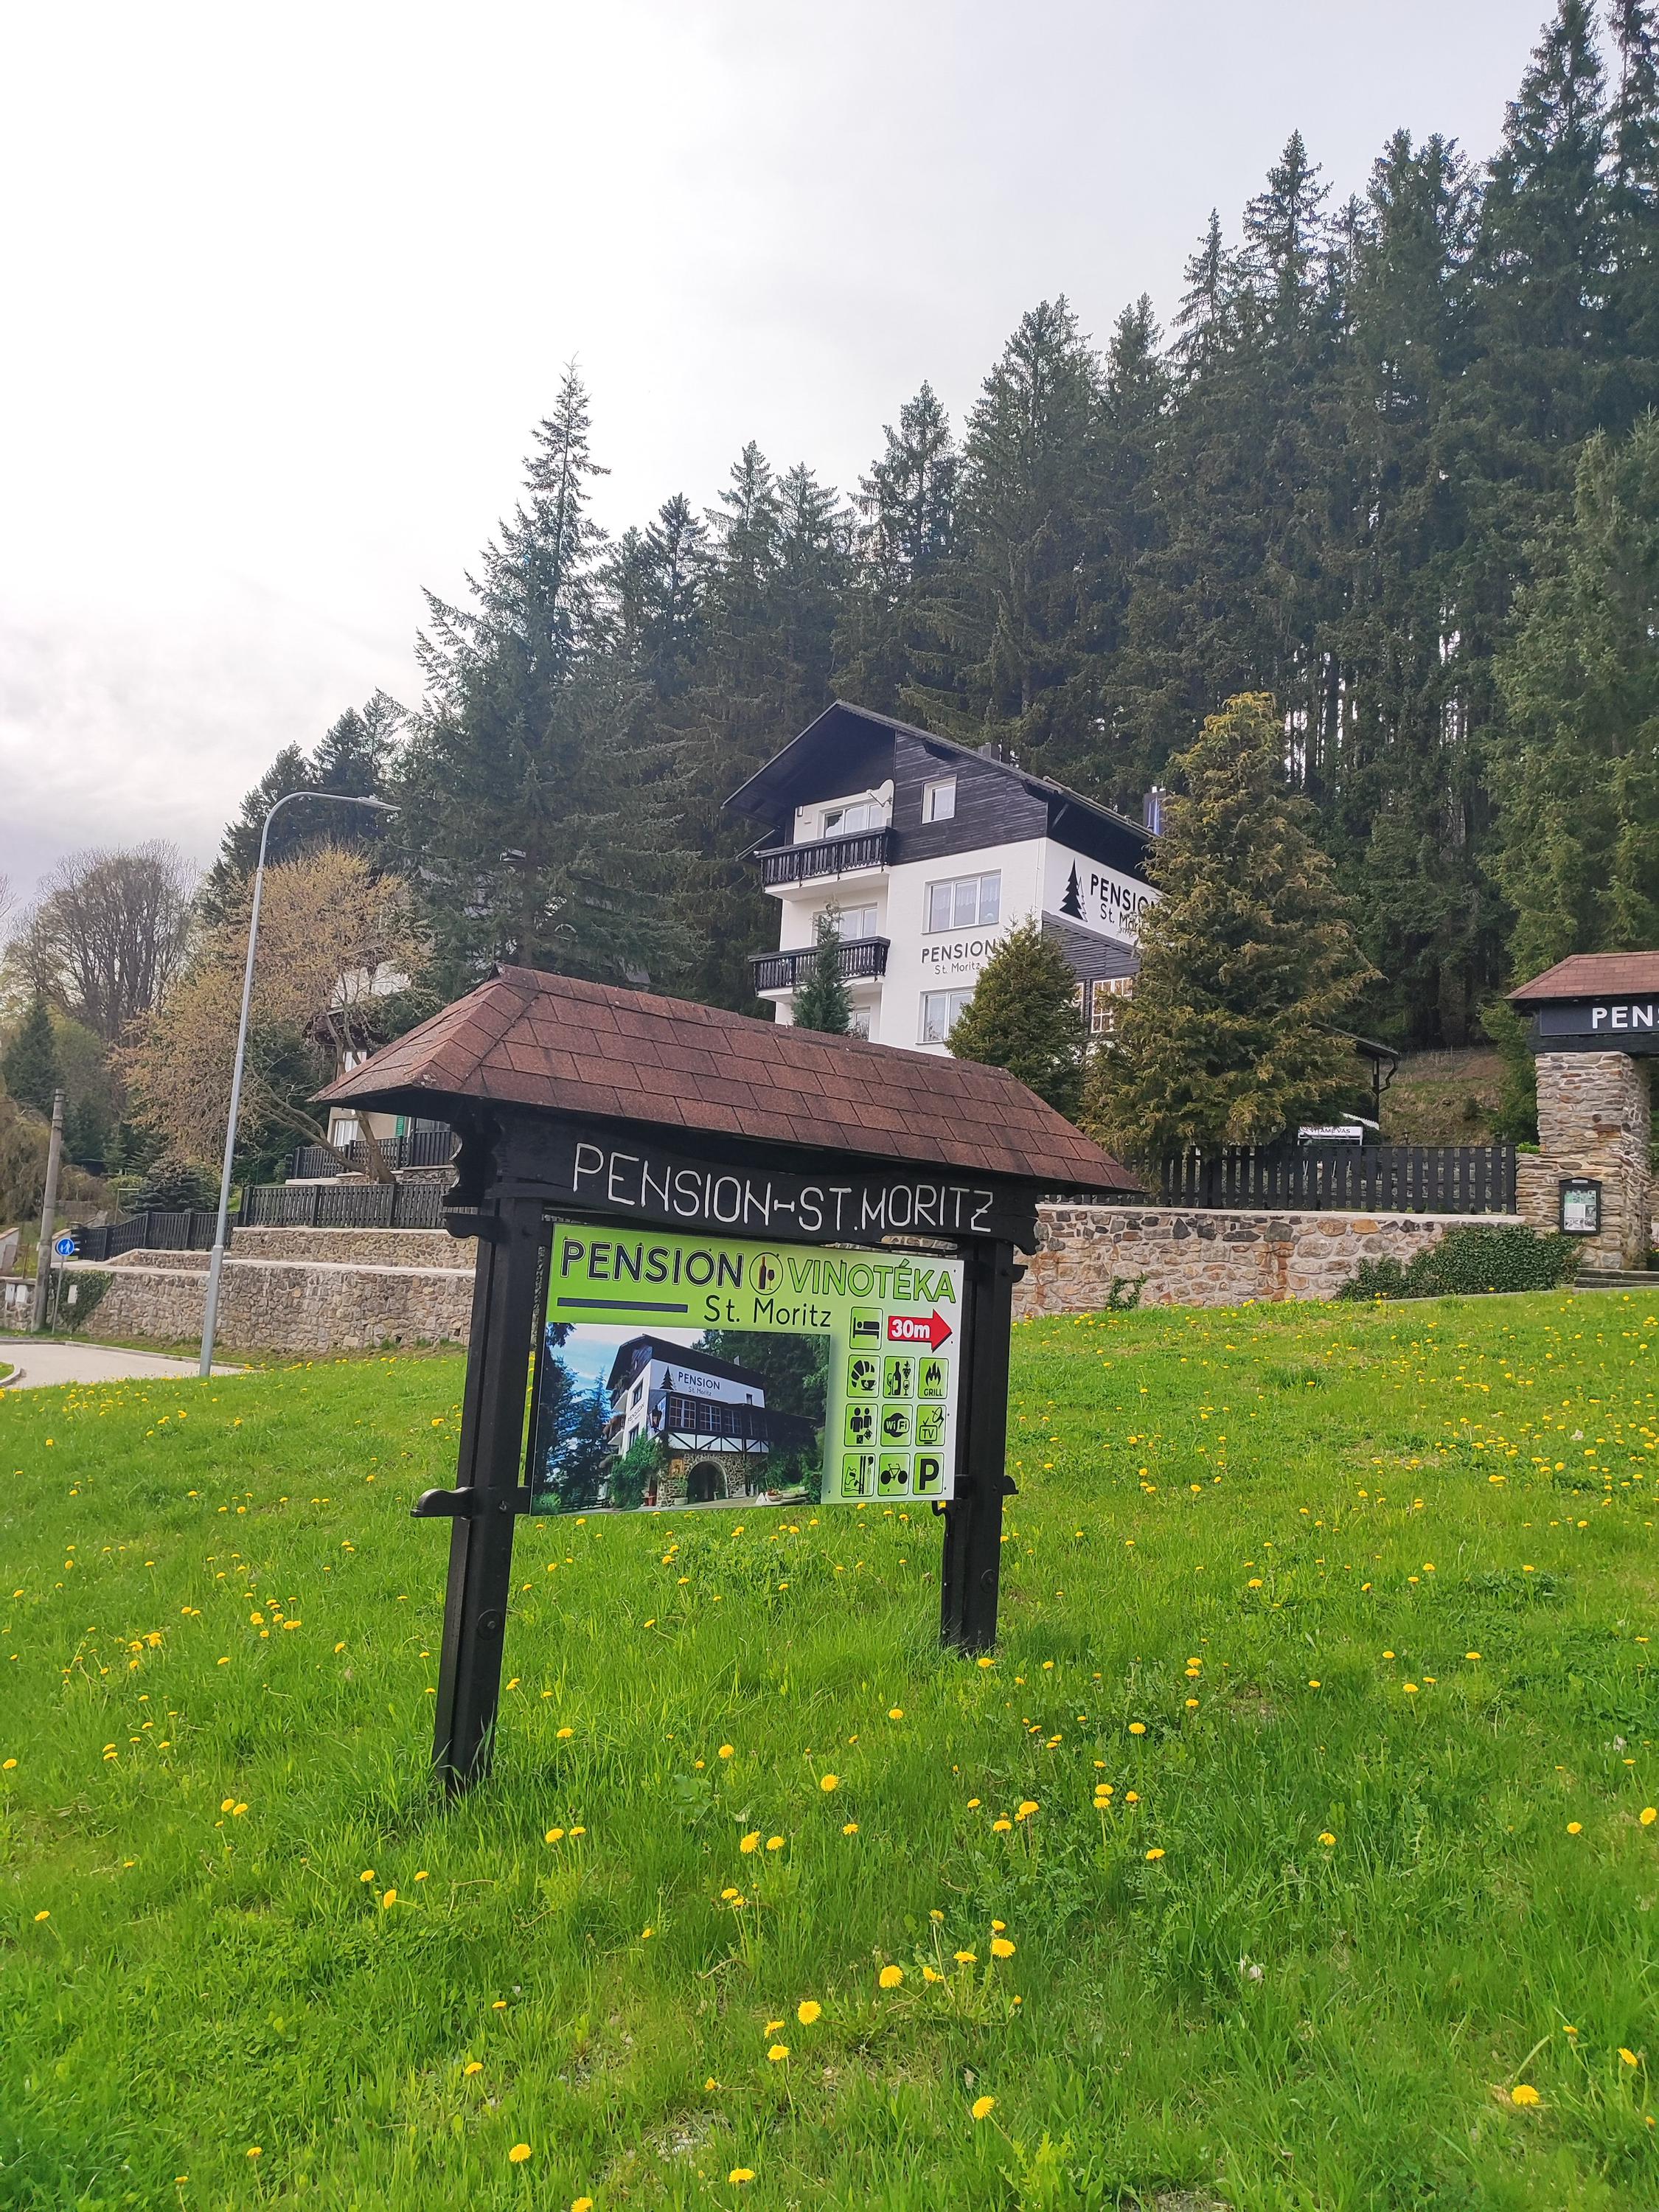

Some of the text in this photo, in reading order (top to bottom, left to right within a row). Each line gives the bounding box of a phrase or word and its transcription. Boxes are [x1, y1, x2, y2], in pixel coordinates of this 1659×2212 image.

[1100, 902, 1115, 924] St.
[922, 938, 996, 964] PENSION
[934, 961, 981, 975] St. Moritz
[1592, 1004, 1659, 1029] PEN
[560, 1238, 956, 1304] PENSION VINOTÉKA
[703, 1294, 832, 1327] St. Moritz
[891, 1318, 931, 1339] 30m
[678, 1371, 720, 1391] PENSION
[696, 1387, 712, 1397] Moritz
[923, 1388, 943, 1397] GRILL
[922, 1428, 935, 1439] TV
[919, 1458, 939, 1490] P
